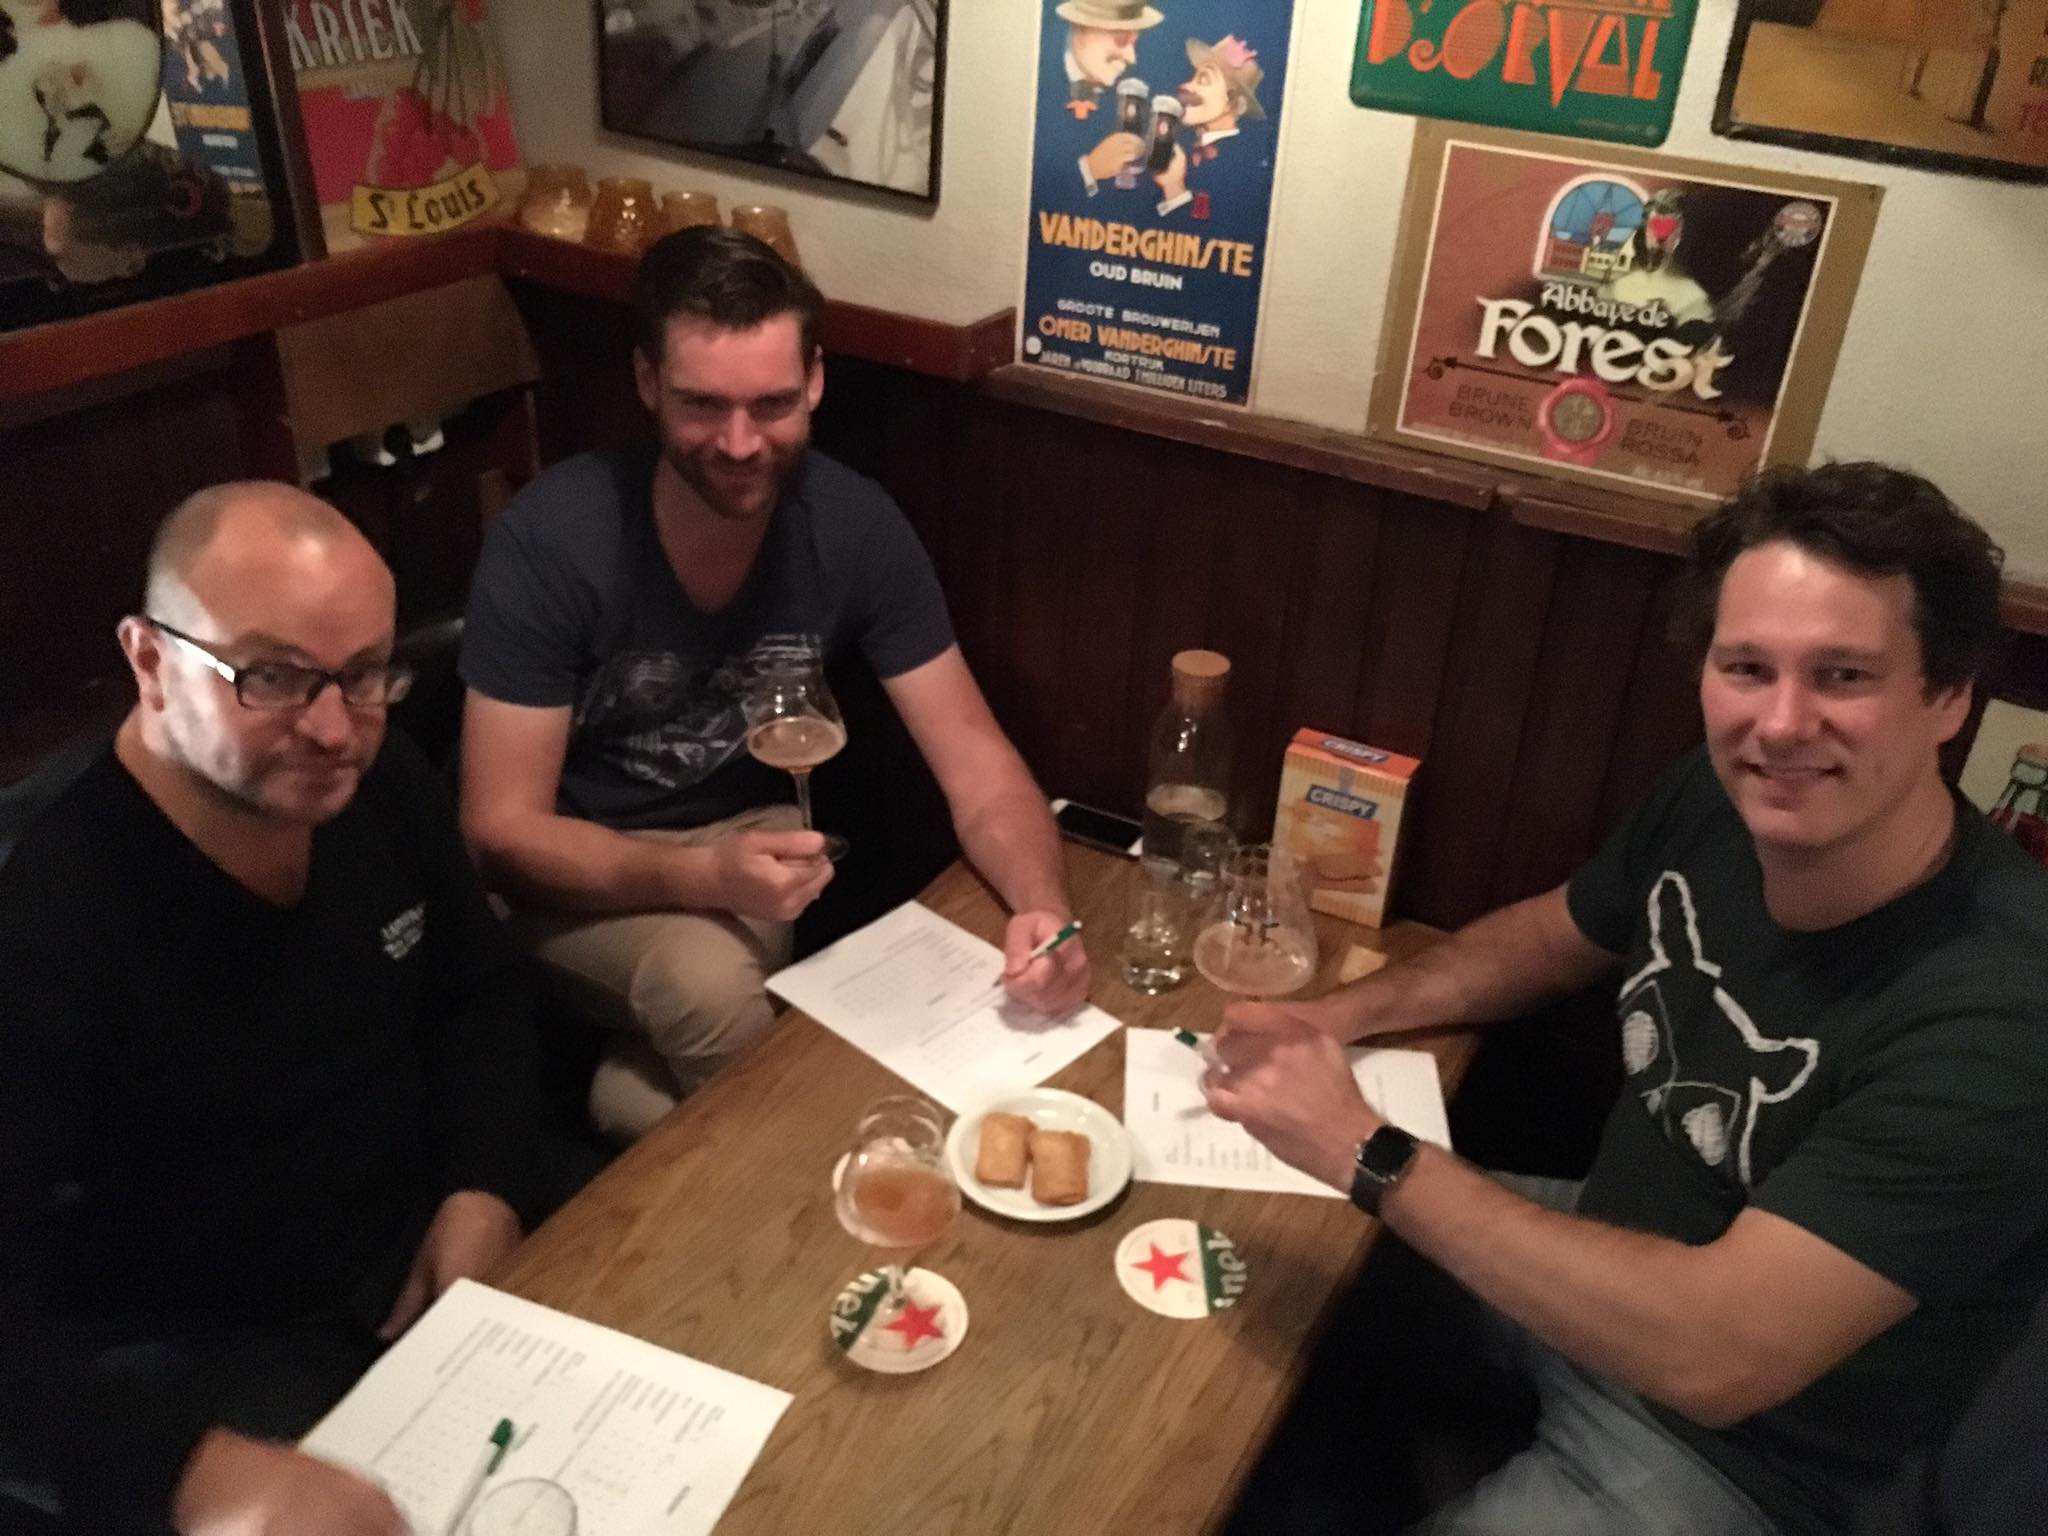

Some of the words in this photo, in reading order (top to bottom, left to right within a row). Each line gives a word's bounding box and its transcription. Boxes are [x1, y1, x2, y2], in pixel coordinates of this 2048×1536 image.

[1038, 211, 1255, 277] VANDERGHINSTE
[1089, 260, 1128, 280] OUD
[1130, 267, 1183, 291] BRUIN
[1056, 299, 1115, 319] GROOTE
[1541, 281, 1636, 328] Abbaye
[1638, 298, 1669, 329] de
[1038, 315, 1092, 344] OMER
[1097, 326, 1237, 371] VANDERGHINSTE
[1474, 296, 1736, 401] Forest
[1449, 402, 1534, 432] BROWN
[1310, 786, 1376, 819] CRISPY
